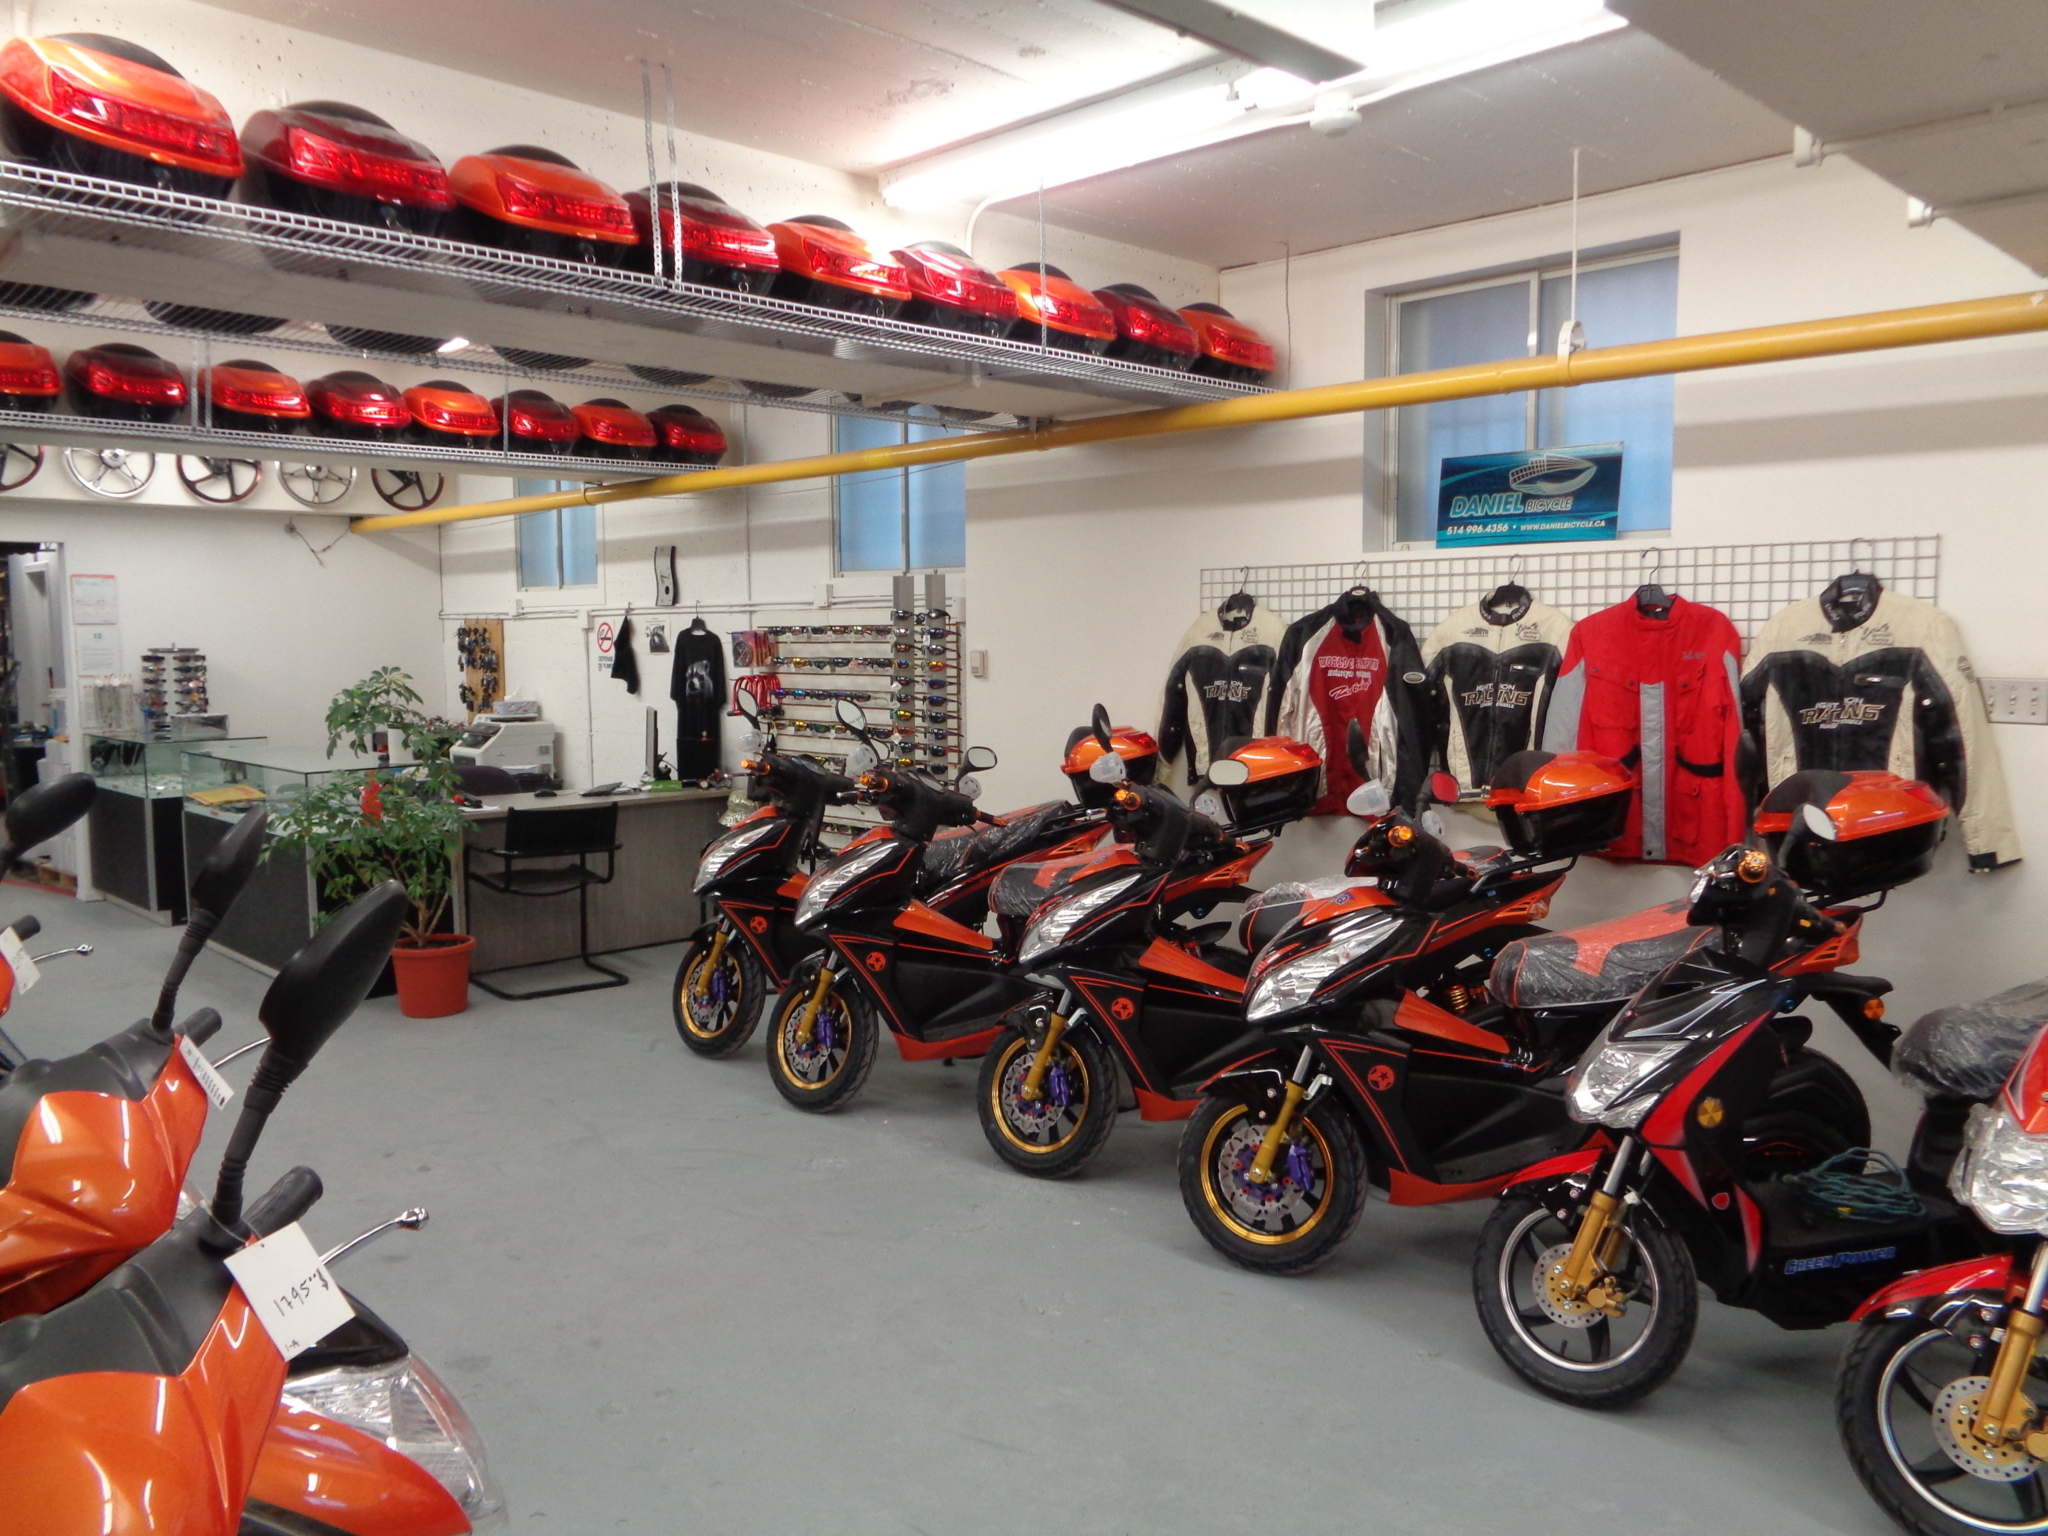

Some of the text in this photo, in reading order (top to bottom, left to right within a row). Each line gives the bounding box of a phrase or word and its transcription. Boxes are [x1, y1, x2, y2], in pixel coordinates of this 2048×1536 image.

[1450, 492, 1574, 518] DANIEL BICYCLE
[1446, 520, 1605, 535] 514 996.4356 WWW.DANIELBICYCLE.CA
[1318, 656, 1348, 668] WORLD
[1784, 1246, 1896, 1275] GREEN POWER
